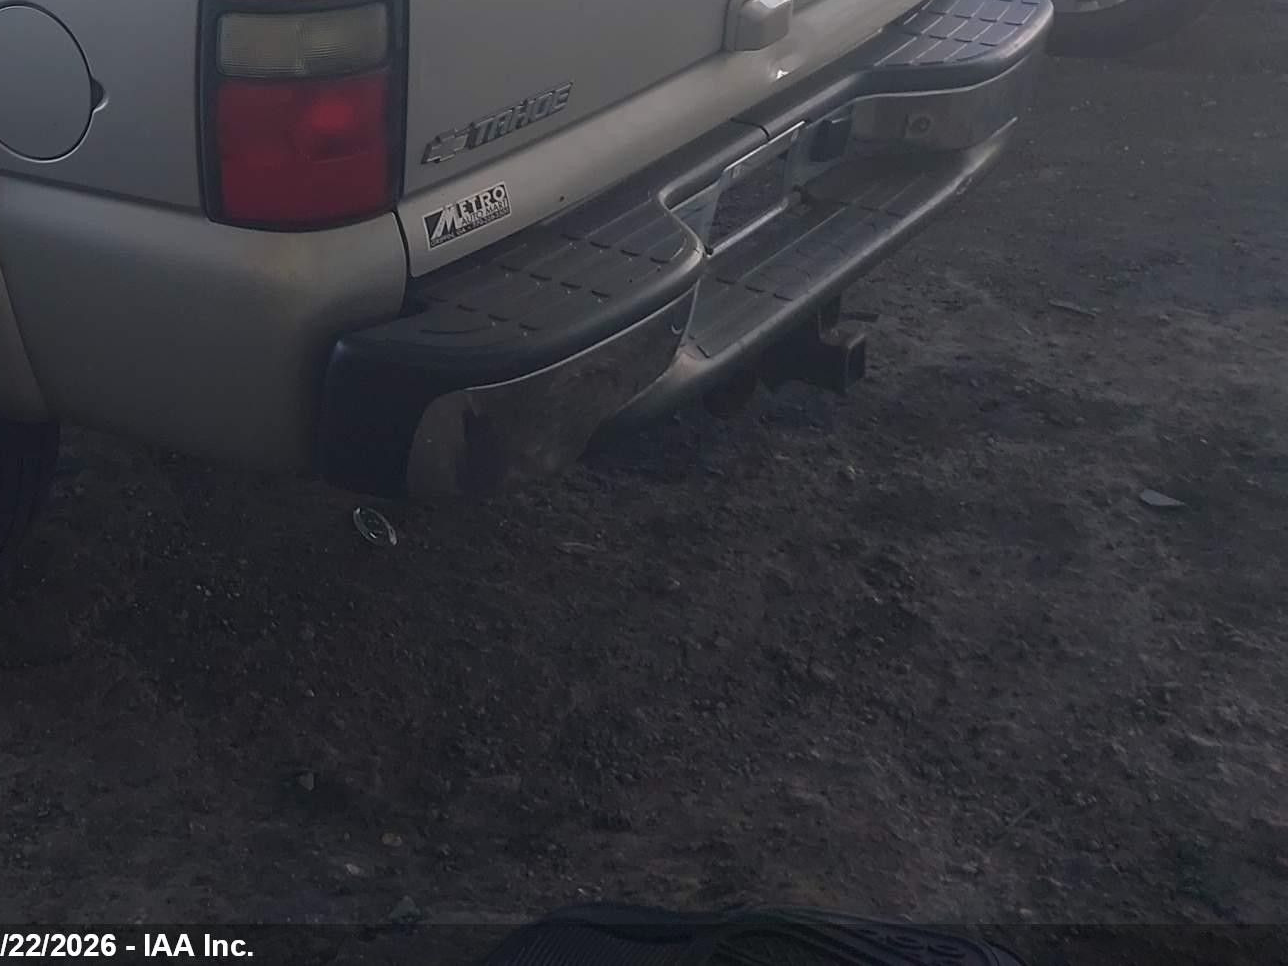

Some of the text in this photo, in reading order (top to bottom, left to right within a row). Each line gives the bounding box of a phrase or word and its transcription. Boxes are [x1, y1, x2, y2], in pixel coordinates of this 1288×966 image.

[469, 81, 573, 147] TAHOE
[430, 186, 506, 239] METRO
[461, 210, 485, 227] AUTO
